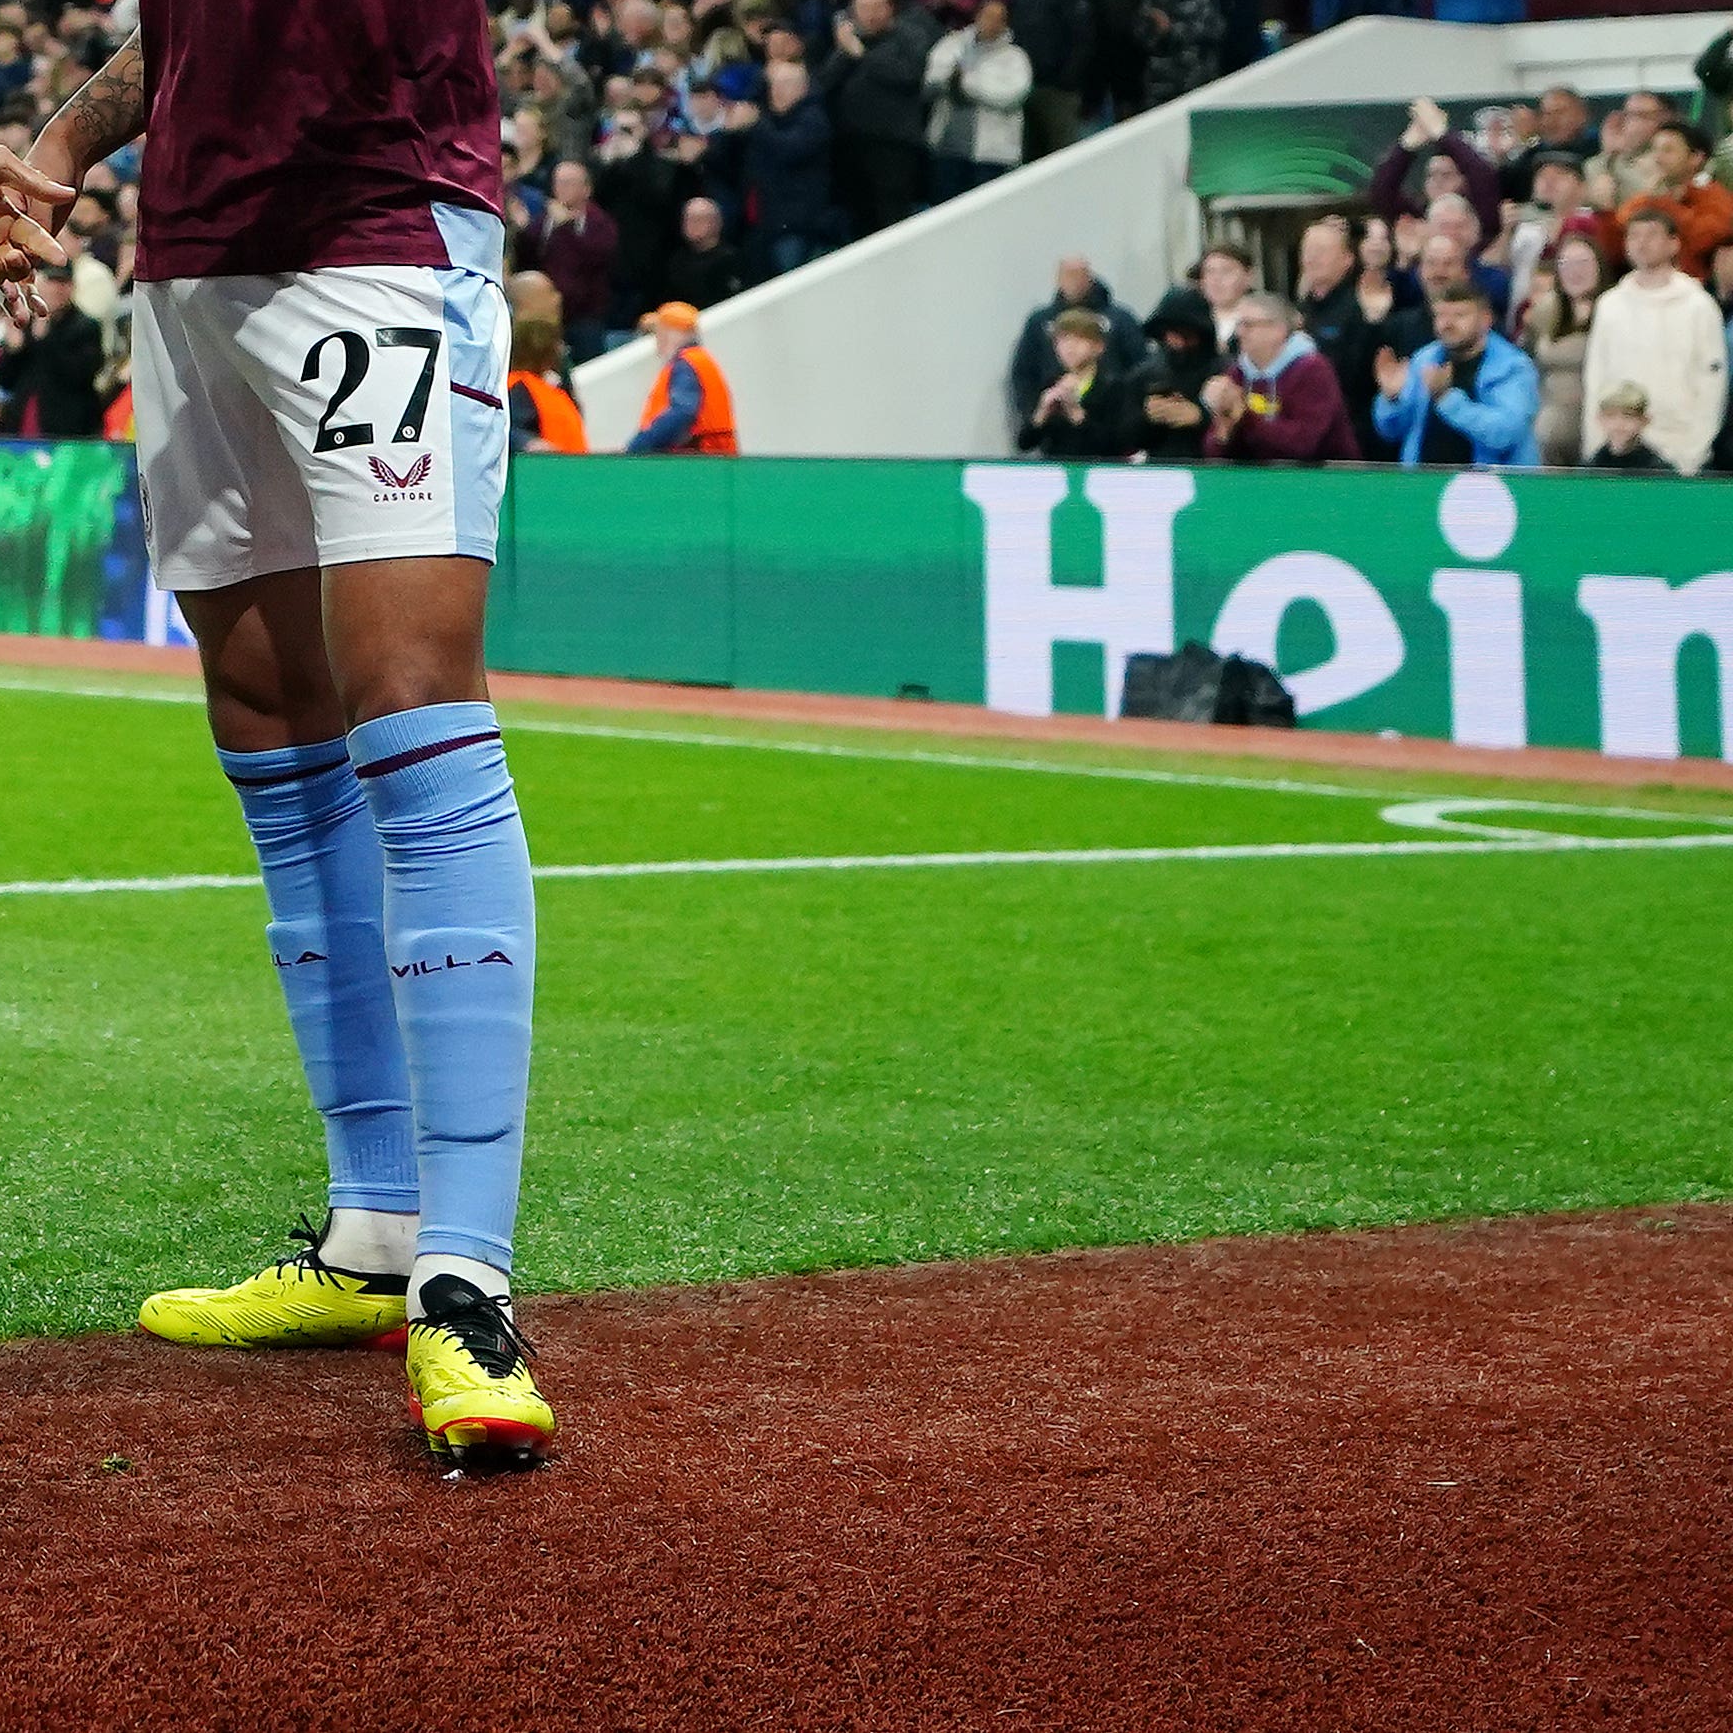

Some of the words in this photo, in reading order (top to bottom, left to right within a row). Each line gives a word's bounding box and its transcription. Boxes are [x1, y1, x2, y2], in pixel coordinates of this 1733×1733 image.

[300, 326, 442, 454] 27
[373, 491, 433, 503] CASTORE
[391, 950, 514, 978] VILLA
